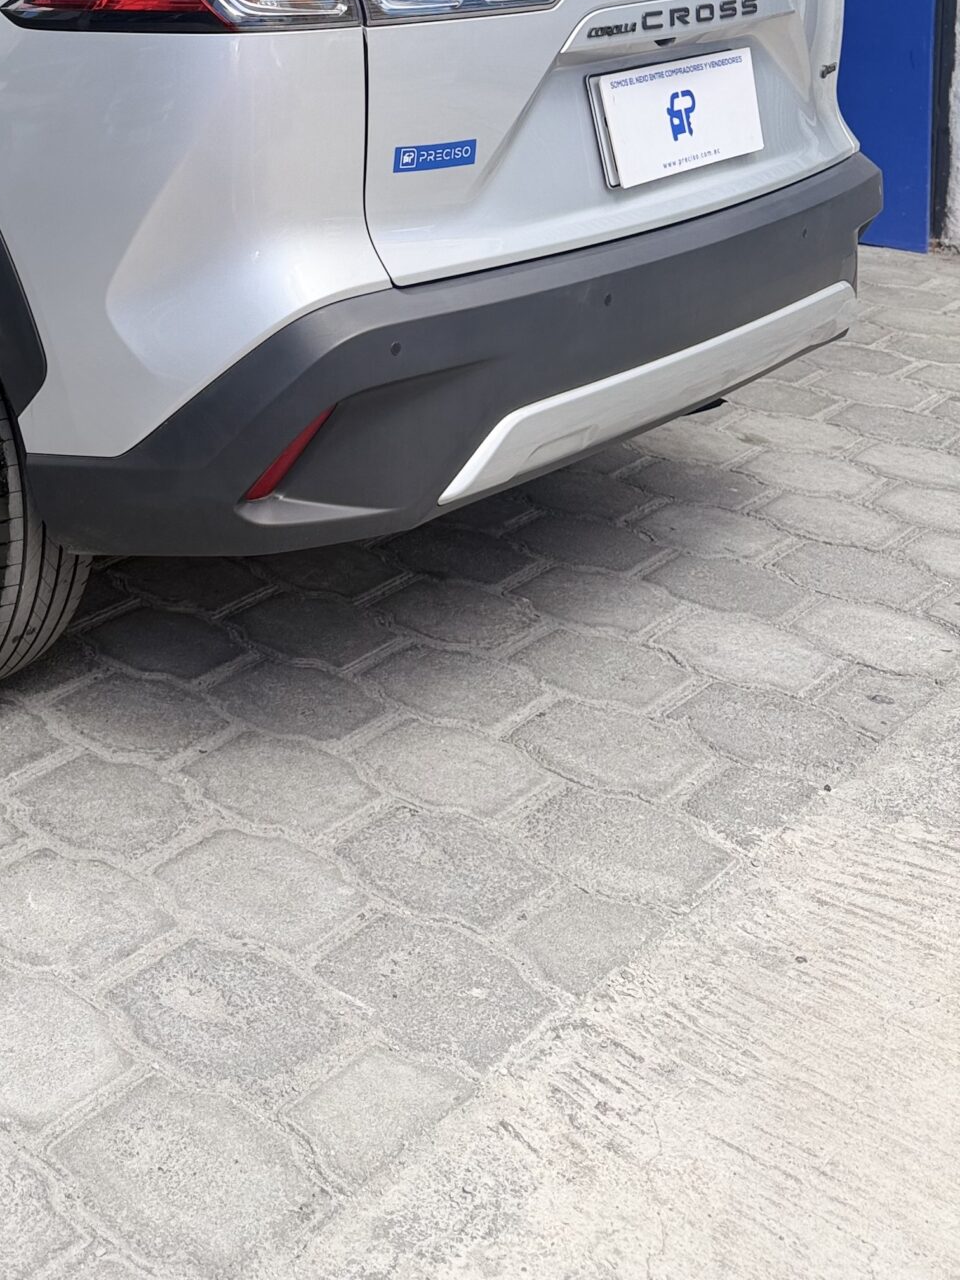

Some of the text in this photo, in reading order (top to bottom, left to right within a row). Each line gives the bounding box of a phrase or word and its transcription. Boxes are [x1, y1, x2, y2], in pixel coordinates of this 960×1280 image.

[587, 21, 637, 39] COROLLA
[610, 77, 629, 89] SOMOS
[665, 63, 704, 77] COMPRADORES
[708, 55, 743, 69] VENDEDORES
[419, 146, 471, 163] PRECISO
